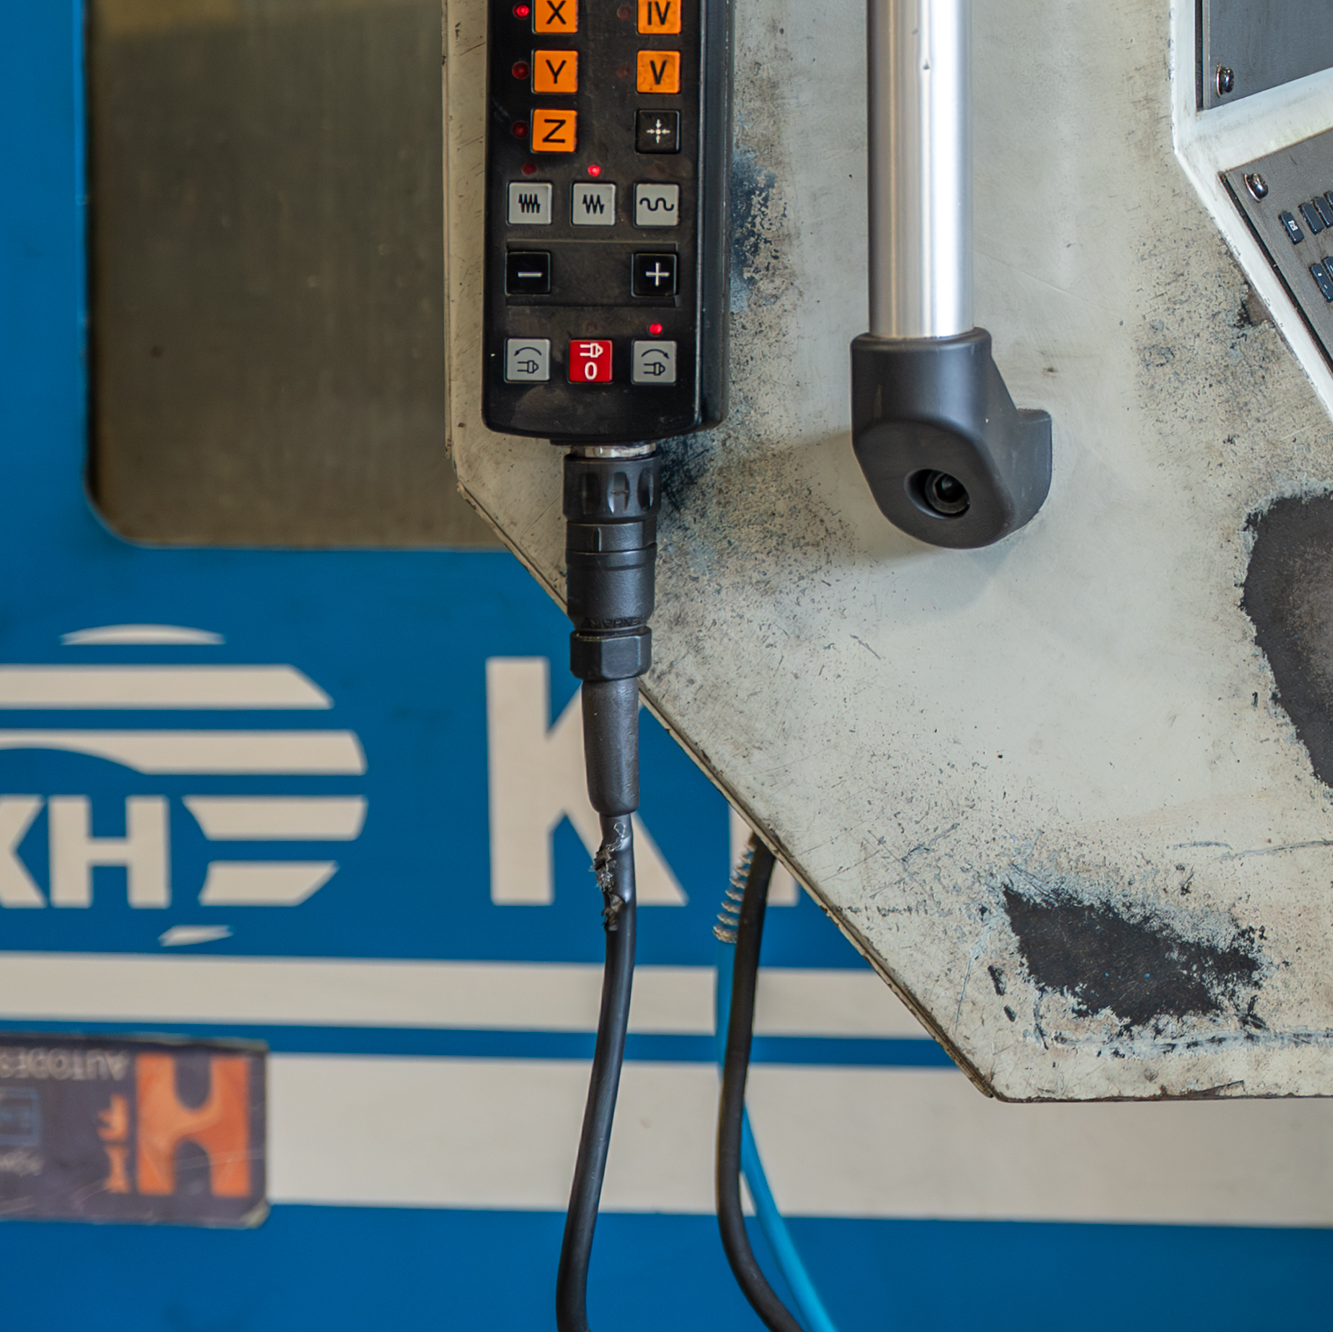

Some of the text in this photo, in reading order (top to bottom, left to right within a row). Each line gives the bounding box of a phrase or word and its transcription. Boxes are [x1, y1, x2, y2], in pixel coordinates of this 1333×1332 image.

[547, 0, 670, 24] X IV
[545, 60, 667, 85] Y V
[543, 120, 566, 143] Z
[584, 362, 596, 380] 0
